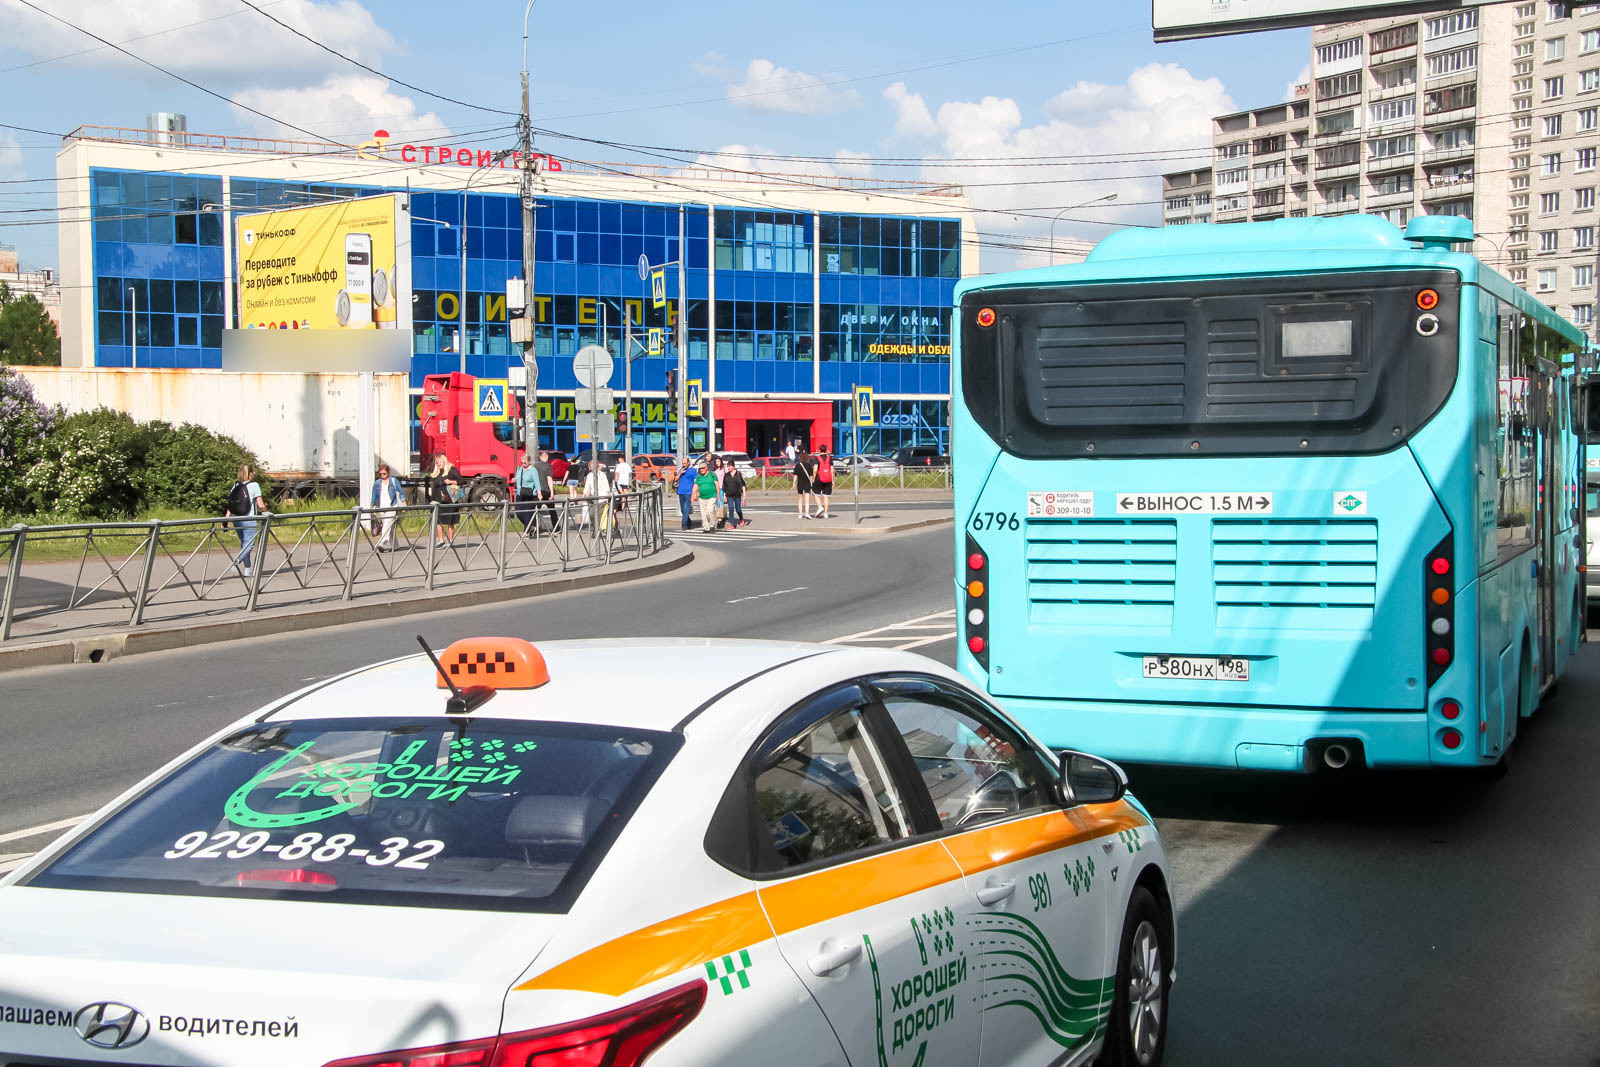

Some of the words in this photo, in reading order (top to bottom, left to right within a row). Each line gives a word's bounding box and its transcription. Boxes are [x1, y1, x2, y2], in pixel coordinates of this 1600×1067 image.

[256, 228, 296, 241] ТИНЬКОФФ
[245, 256, 296, 272] Переводите
[245, 279, 255, 288] за
[256, 274, 283, 290] рубеж
[285, 276, 290, 285] с
[291, 268, 338, 285] Тинькофф
[246, 298, 269, 309] Онлайн
[274, 297, 285, 306] без
[286, 295, 316, 305] комиссии
[841, 314, 887, 325] ДВЕРИ
[901, 316, 939, 326] ОКНА
[869, 343, 916, 355] ОДЕЖДЫ
[919, 345, 926, 354] И
[882, 414, 918, 424] OZON
[1136, 496, 1203, 511] ВЫНОС
[1210, 496, 1232, 511] 1.5
[1238, 496, 1253, 511] М
[1341, 499, 1358, 507] СПГ
[972, 512, 1020, 531] 6796
[1218, 661, 1244, 673] 198
[300, 763, 522, 785] ХОРОШЕЙ
[275, 780, 469, 802] ДОРОГИ
[164, 830, 446, 870] 929-88-32
[1028, 871, 1052, 912] 981
[891, 950, 967, 1013] ХОРОШЕЙ
[159, 1015, 299, 1038] водителей
[892, 995, 955, 1056] ДОРОГИ
